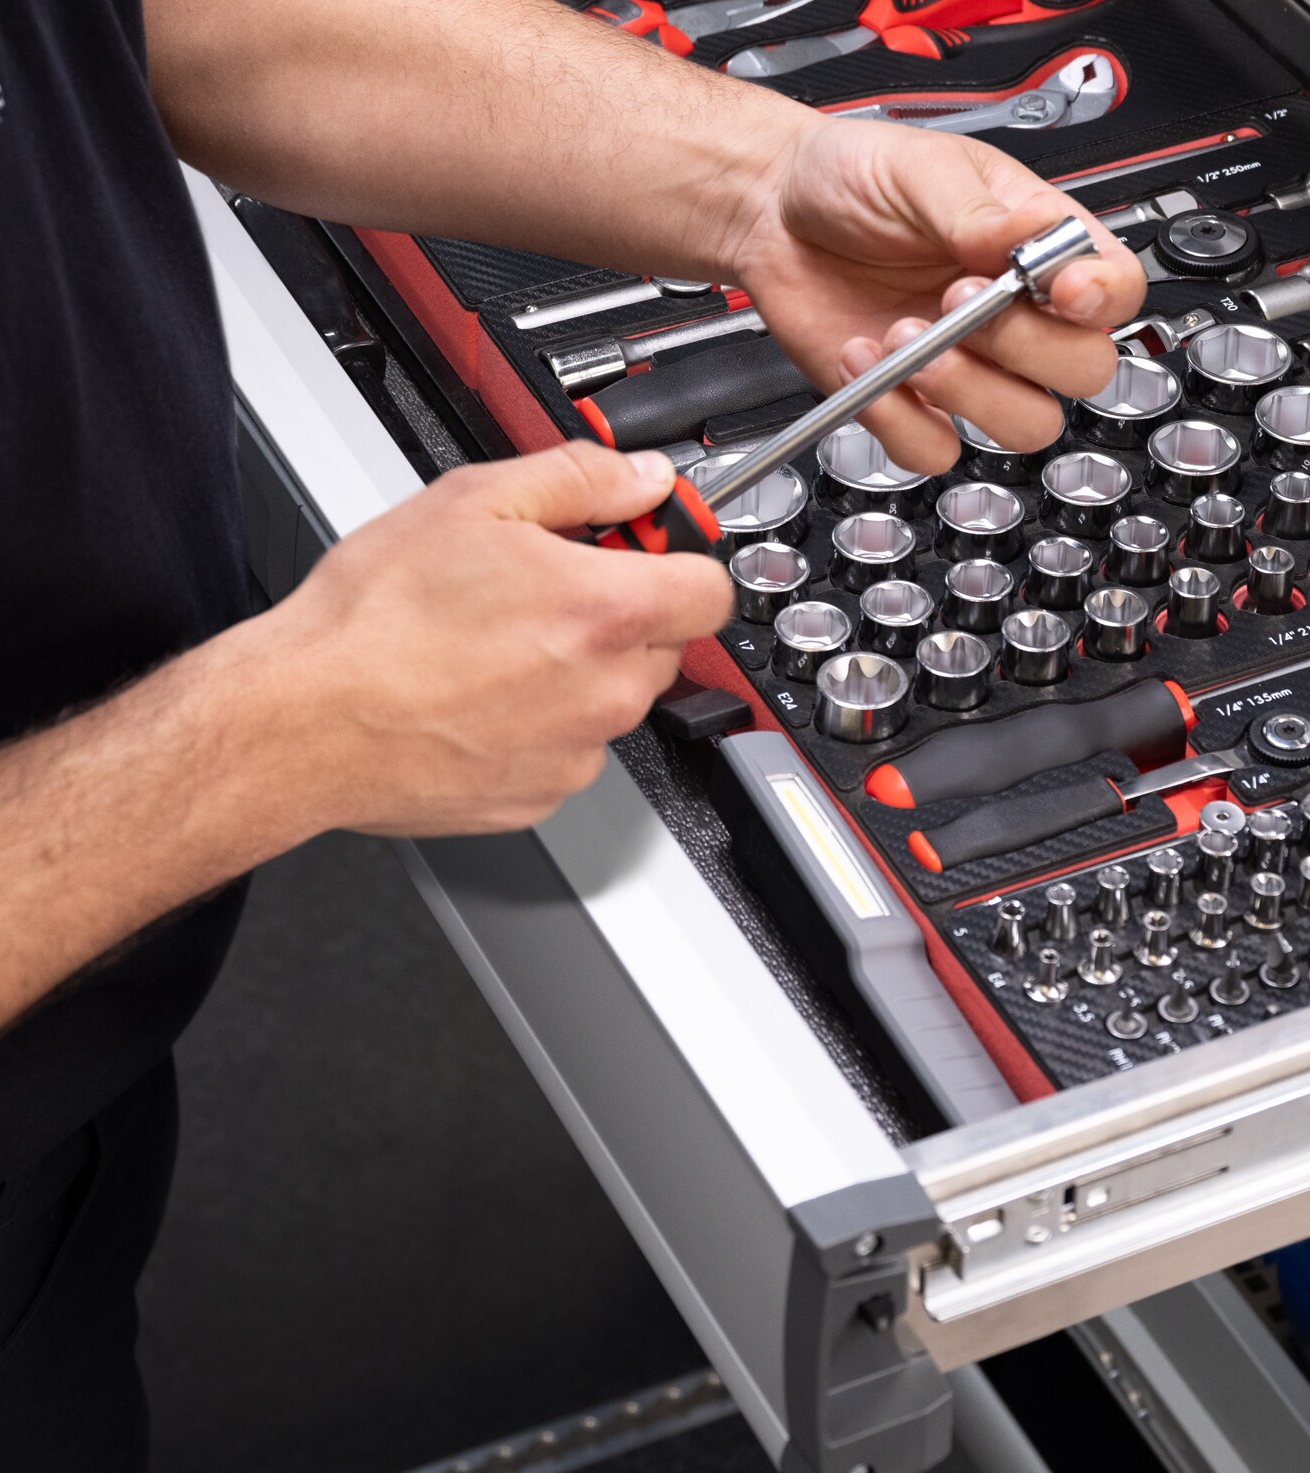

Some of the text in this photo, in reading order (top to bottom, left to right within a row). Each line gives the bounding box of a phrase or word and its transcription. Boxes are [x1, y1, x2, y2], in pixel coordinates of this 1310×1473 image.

[1222, 161, 1262, 177] 250mm
[1220, 296, 1238, 312] T20
[738, 639, 755, 652] 17
[1268, 631, 1296, 646] 1/4"
[777, 692, 798, 711] E24
[1216, 688, 1293, 717] 1/4" 135mm
[1241, 773, 1270, 789] 1/4"
